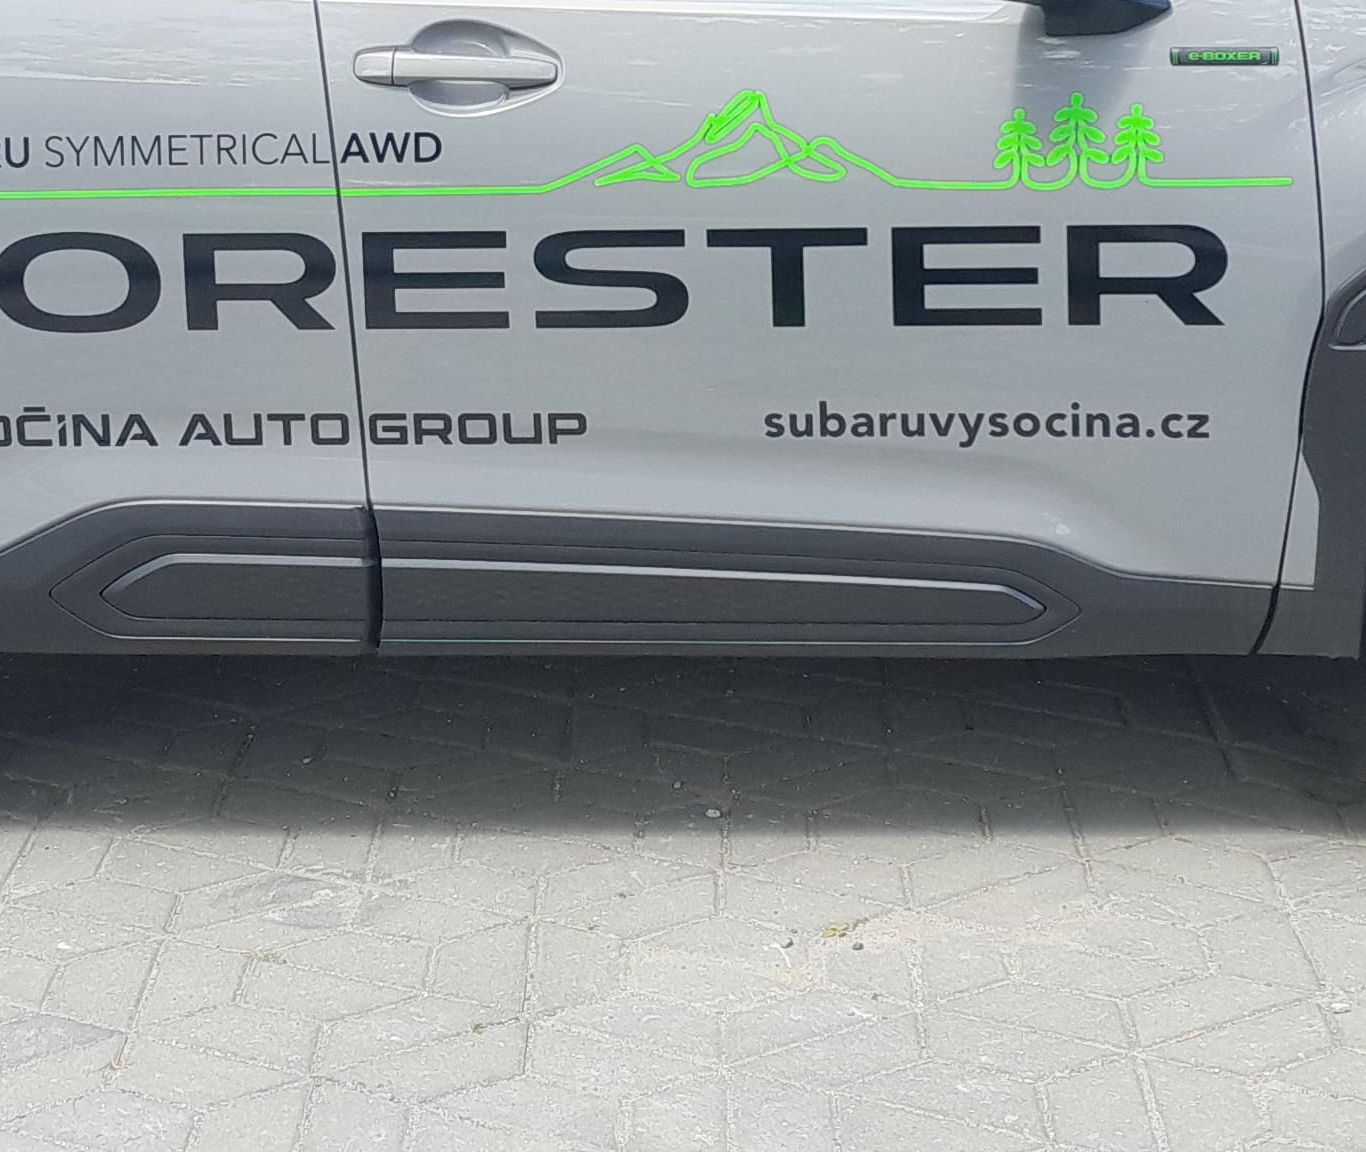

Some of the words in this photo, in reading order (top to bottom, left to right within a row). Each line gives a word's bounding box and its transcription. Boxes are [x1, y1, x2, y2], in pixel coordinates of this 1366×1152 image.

[1188, 51, 1261, 61] e-BOXER
[44, 132, 331, 168] SYMMETRICAL
[340, 132, 442, 164] AWD
[178, 413, 350, 448] AUTO
[368, 412, 588, 446] GROUP
[764, 400, 1210, 448] subaruvysocina.cz
